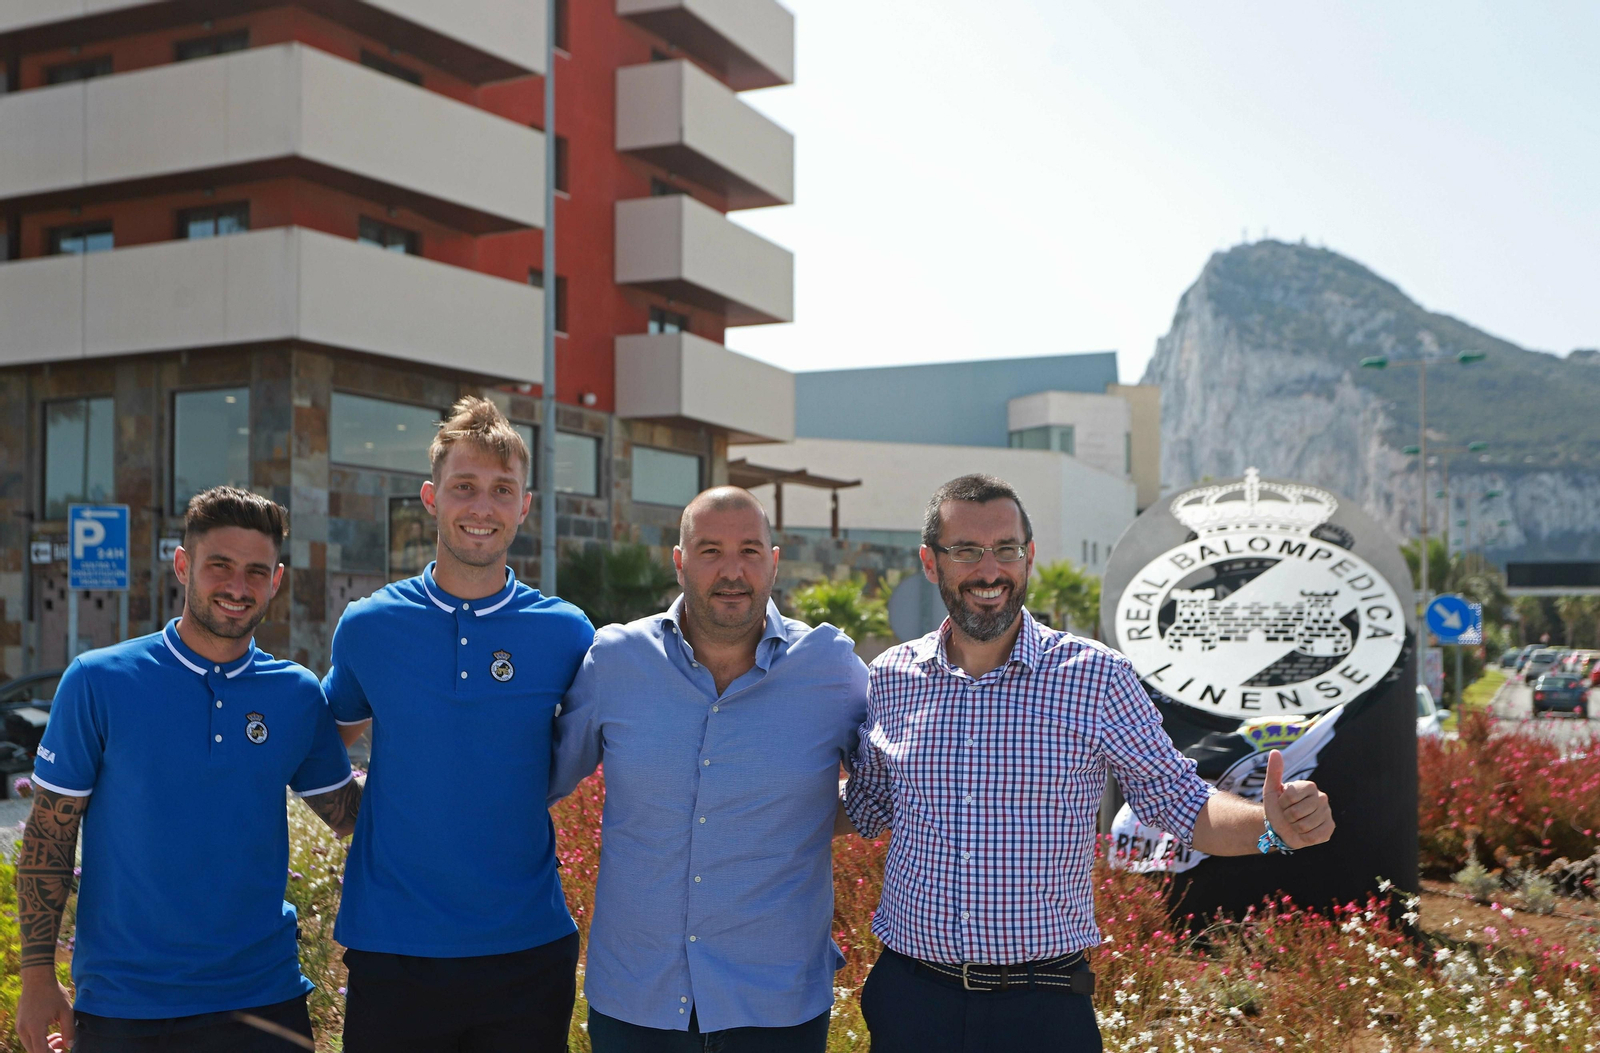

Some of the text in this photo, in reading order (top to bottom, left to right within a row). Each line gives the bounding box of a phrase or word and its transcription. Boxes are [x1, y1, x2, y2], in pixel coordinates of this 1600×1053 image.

[74, 519, 106, 559] P
[1126, 536, 1394, 642] REAL BALOMPEDICA
[1151, 663, 1370, 711] LINENSE
